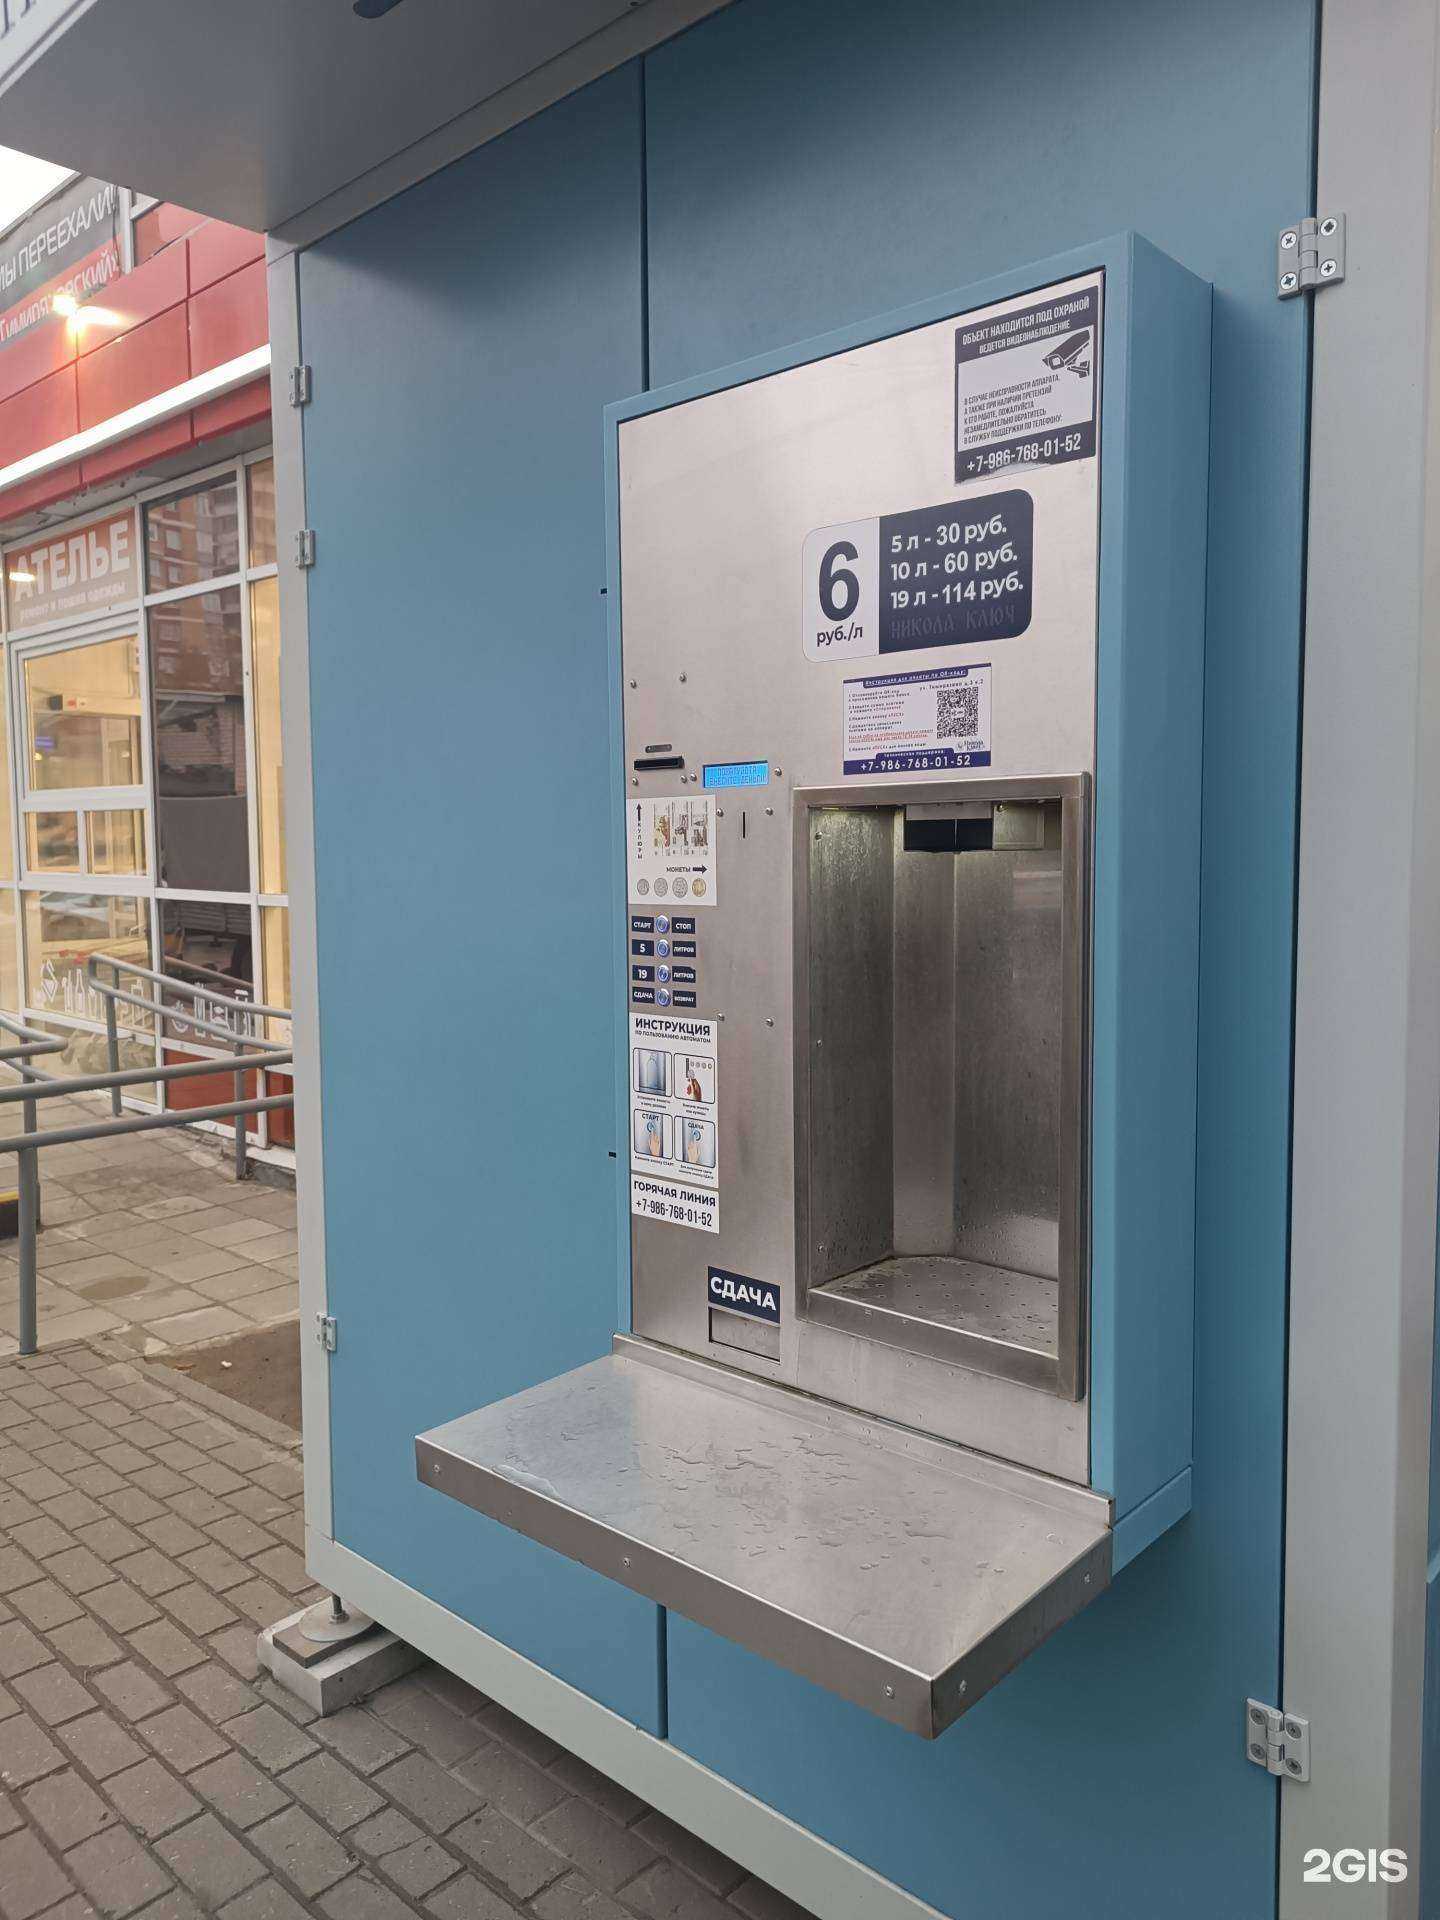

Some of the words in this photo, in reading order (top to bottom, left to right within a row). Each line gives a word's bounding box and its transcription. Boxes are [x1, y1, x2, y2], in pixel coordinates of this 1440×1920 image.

[962, 327, 990, 345] ОБЪЕКТ
[990, 315, 1035, 337] НАХОДИТСЯ
[1035, 309, 1053, 324] ПОД
[1053, 295, 1090, 319] ОХРАНОЙ
[979, 339, 1006, 354] ВЕДЕТСЯ
[1006, 319, 1071, 346] ВИДЕОНАБЛЮДЕНИЕ
[891, 535, 902, 553] 5
[906, 535, 919, 551] л
[936, 522, 960, 546] 30
[964, 513, 1008, 544] руб.
[15, 519, 131, 603] АТЕЛЬЕ
[891, 561, 910, 581] 10
[914, 560, 927, 577] л
[944, 550, 969, 574] 60
[975, 541, 1018, 572] руб.
[819, 540, 859, 622] 6
[891, 589, 910, 609] 19
[913, 589, 926, 606] л
[942, 580, 976, 605] 114
[980, 570, 1024, 600] руб.
[816, 622, 863, 647] руб./л
[890, 613, 956, 640] НИКОЛА
[966, 604, 1016, 630] КЛЮЧ
[860, 754, 971, 772] +7-986-768-01-52
[633, 921, 652, 929] СТАРТ
[639, 943, 646, 953] 5
[638, 968, 648, 979] 19
[633, 991, 654, 999] СДАЧА
[635, 1017, 711, 1036] ИНСТРУКЦИЯ
[642, 1030, 680, 1040] ПОЛЬЗОВАНИЮ
[680, 1034, 711, 1043] АВТОМАТОМ
[641, 1113, 660, 1121] СТАРТ
[634, 1180, 677, 1198] ГОРЯЧАЯ
[679, 1190, 716, 1207] ЛИНИЯ
[636, 1198, 712, 1227] +7-986-768-01-52
[710, 1276, 777, 1311] СДАЧА
